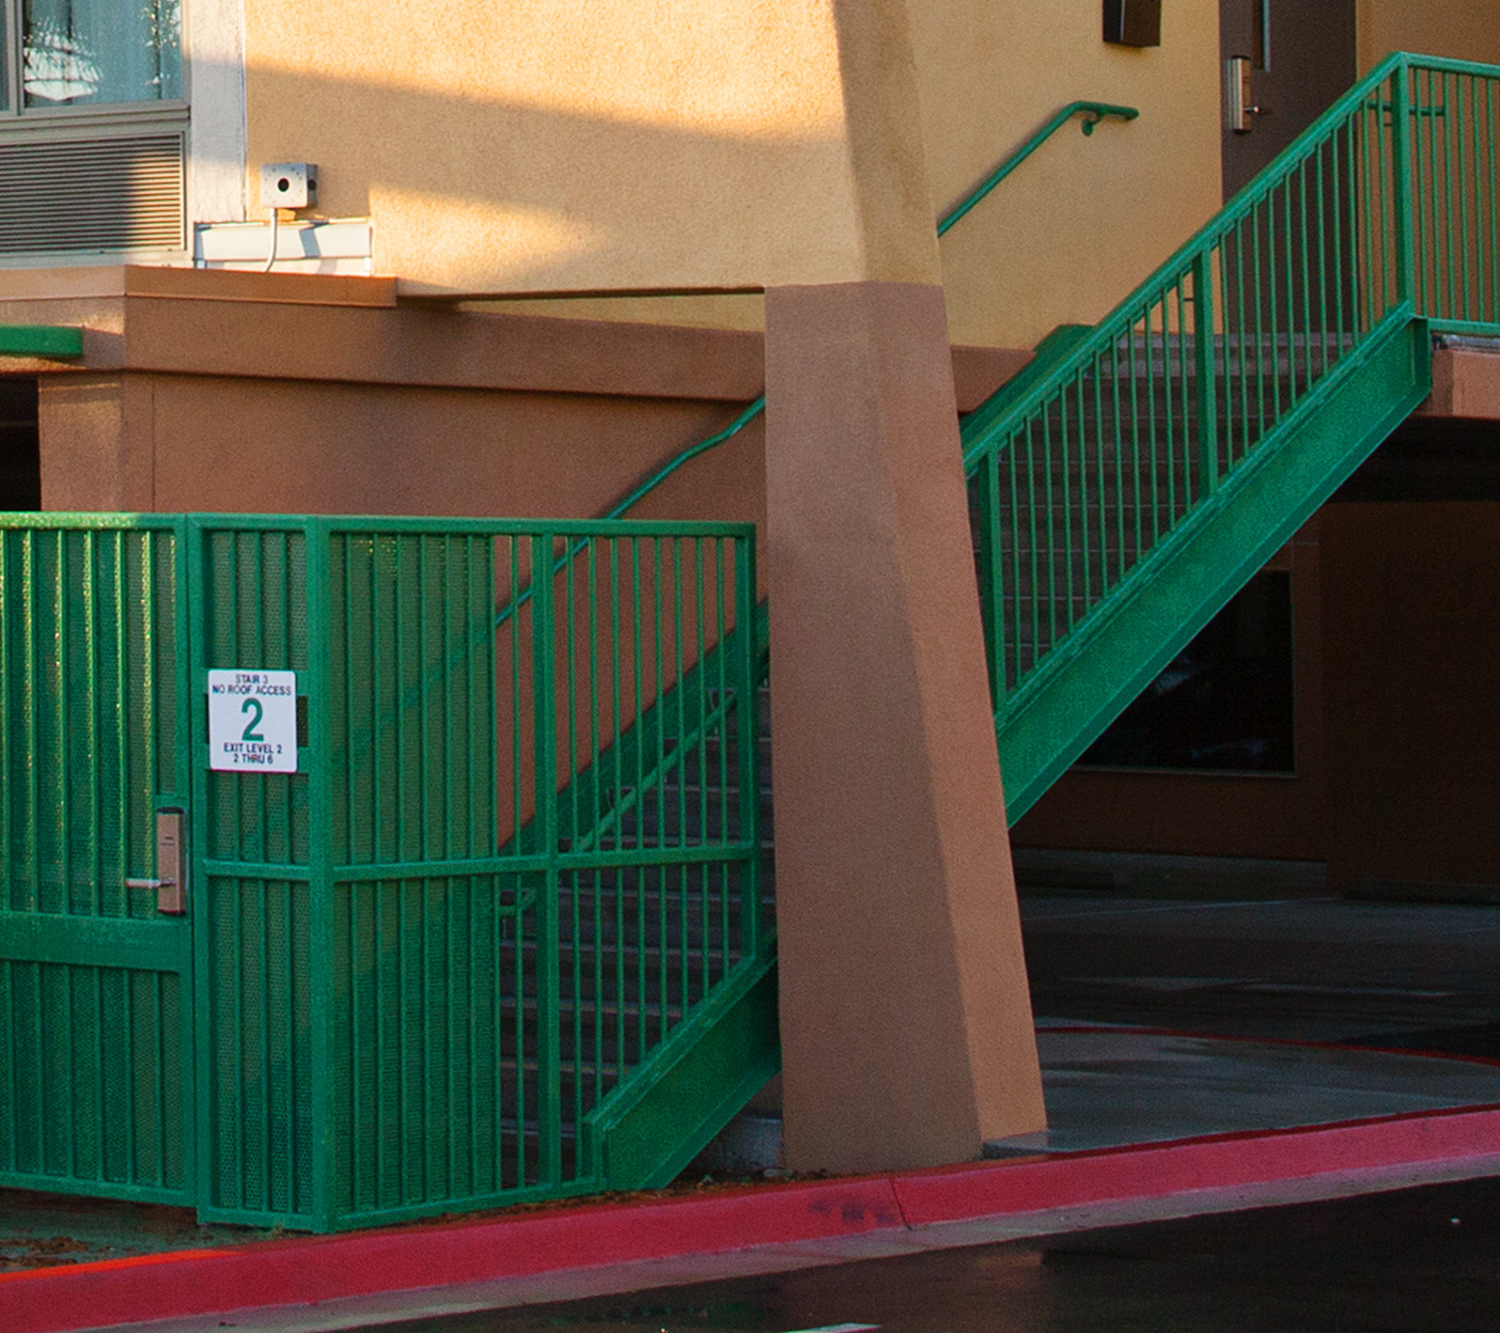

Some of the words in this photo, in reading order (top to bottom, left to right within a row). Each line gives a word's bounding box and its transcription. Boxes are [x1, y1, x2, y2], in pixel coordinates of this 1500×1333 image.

[235, 674, 260, 684] STAIR
[263, 675, 269, 684] 3
[212, 686, 225, 694] NO
[227, 686, 252, 694] ROOF
[255, 686, 292, 695] ACCESS
[241, 697, 264, 741] 2
[223, 743, 243, 752] EXIT
[246, 743, 273, 753] LEVEL
[277, 744, 283, 754] 2
[233, 754, 239, 763] 2
[242, 754, 265, 764] THRU
[267, 755, 273, 764] 6
